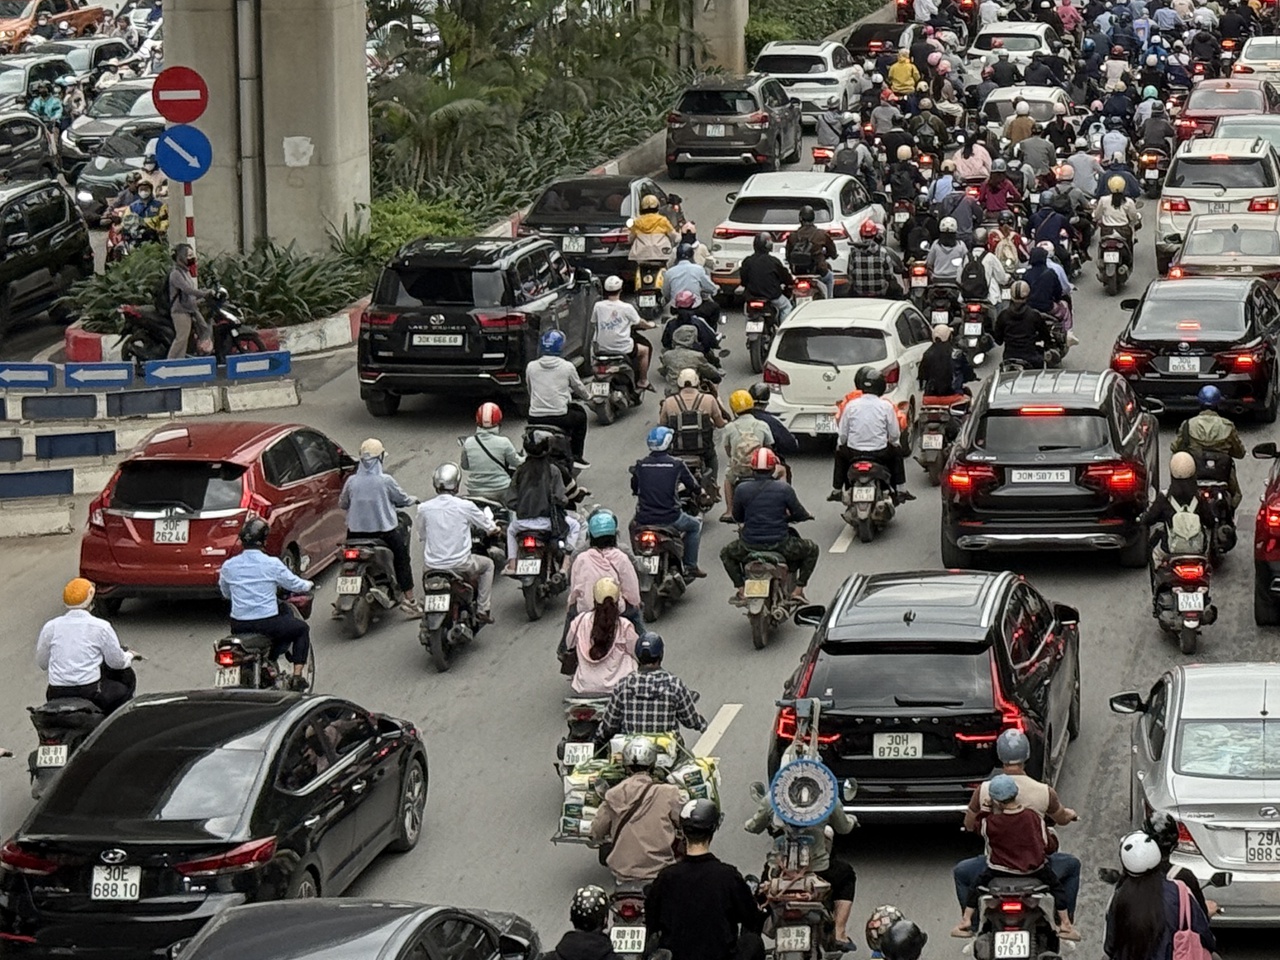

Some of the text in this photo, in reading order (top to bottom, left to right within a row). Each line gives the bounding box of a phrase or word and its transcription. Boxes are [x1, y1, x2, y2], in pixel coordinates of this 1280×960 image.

[163, 520, 182, 531] 30F
[886, 734, 909, 746] 30H
[878, 746, 918, 758] 879.43
[1257, 832, 1280, 847] 29A
[104, 865, 129, 882] 30E
[93, 882, 139, 899] 688.10
